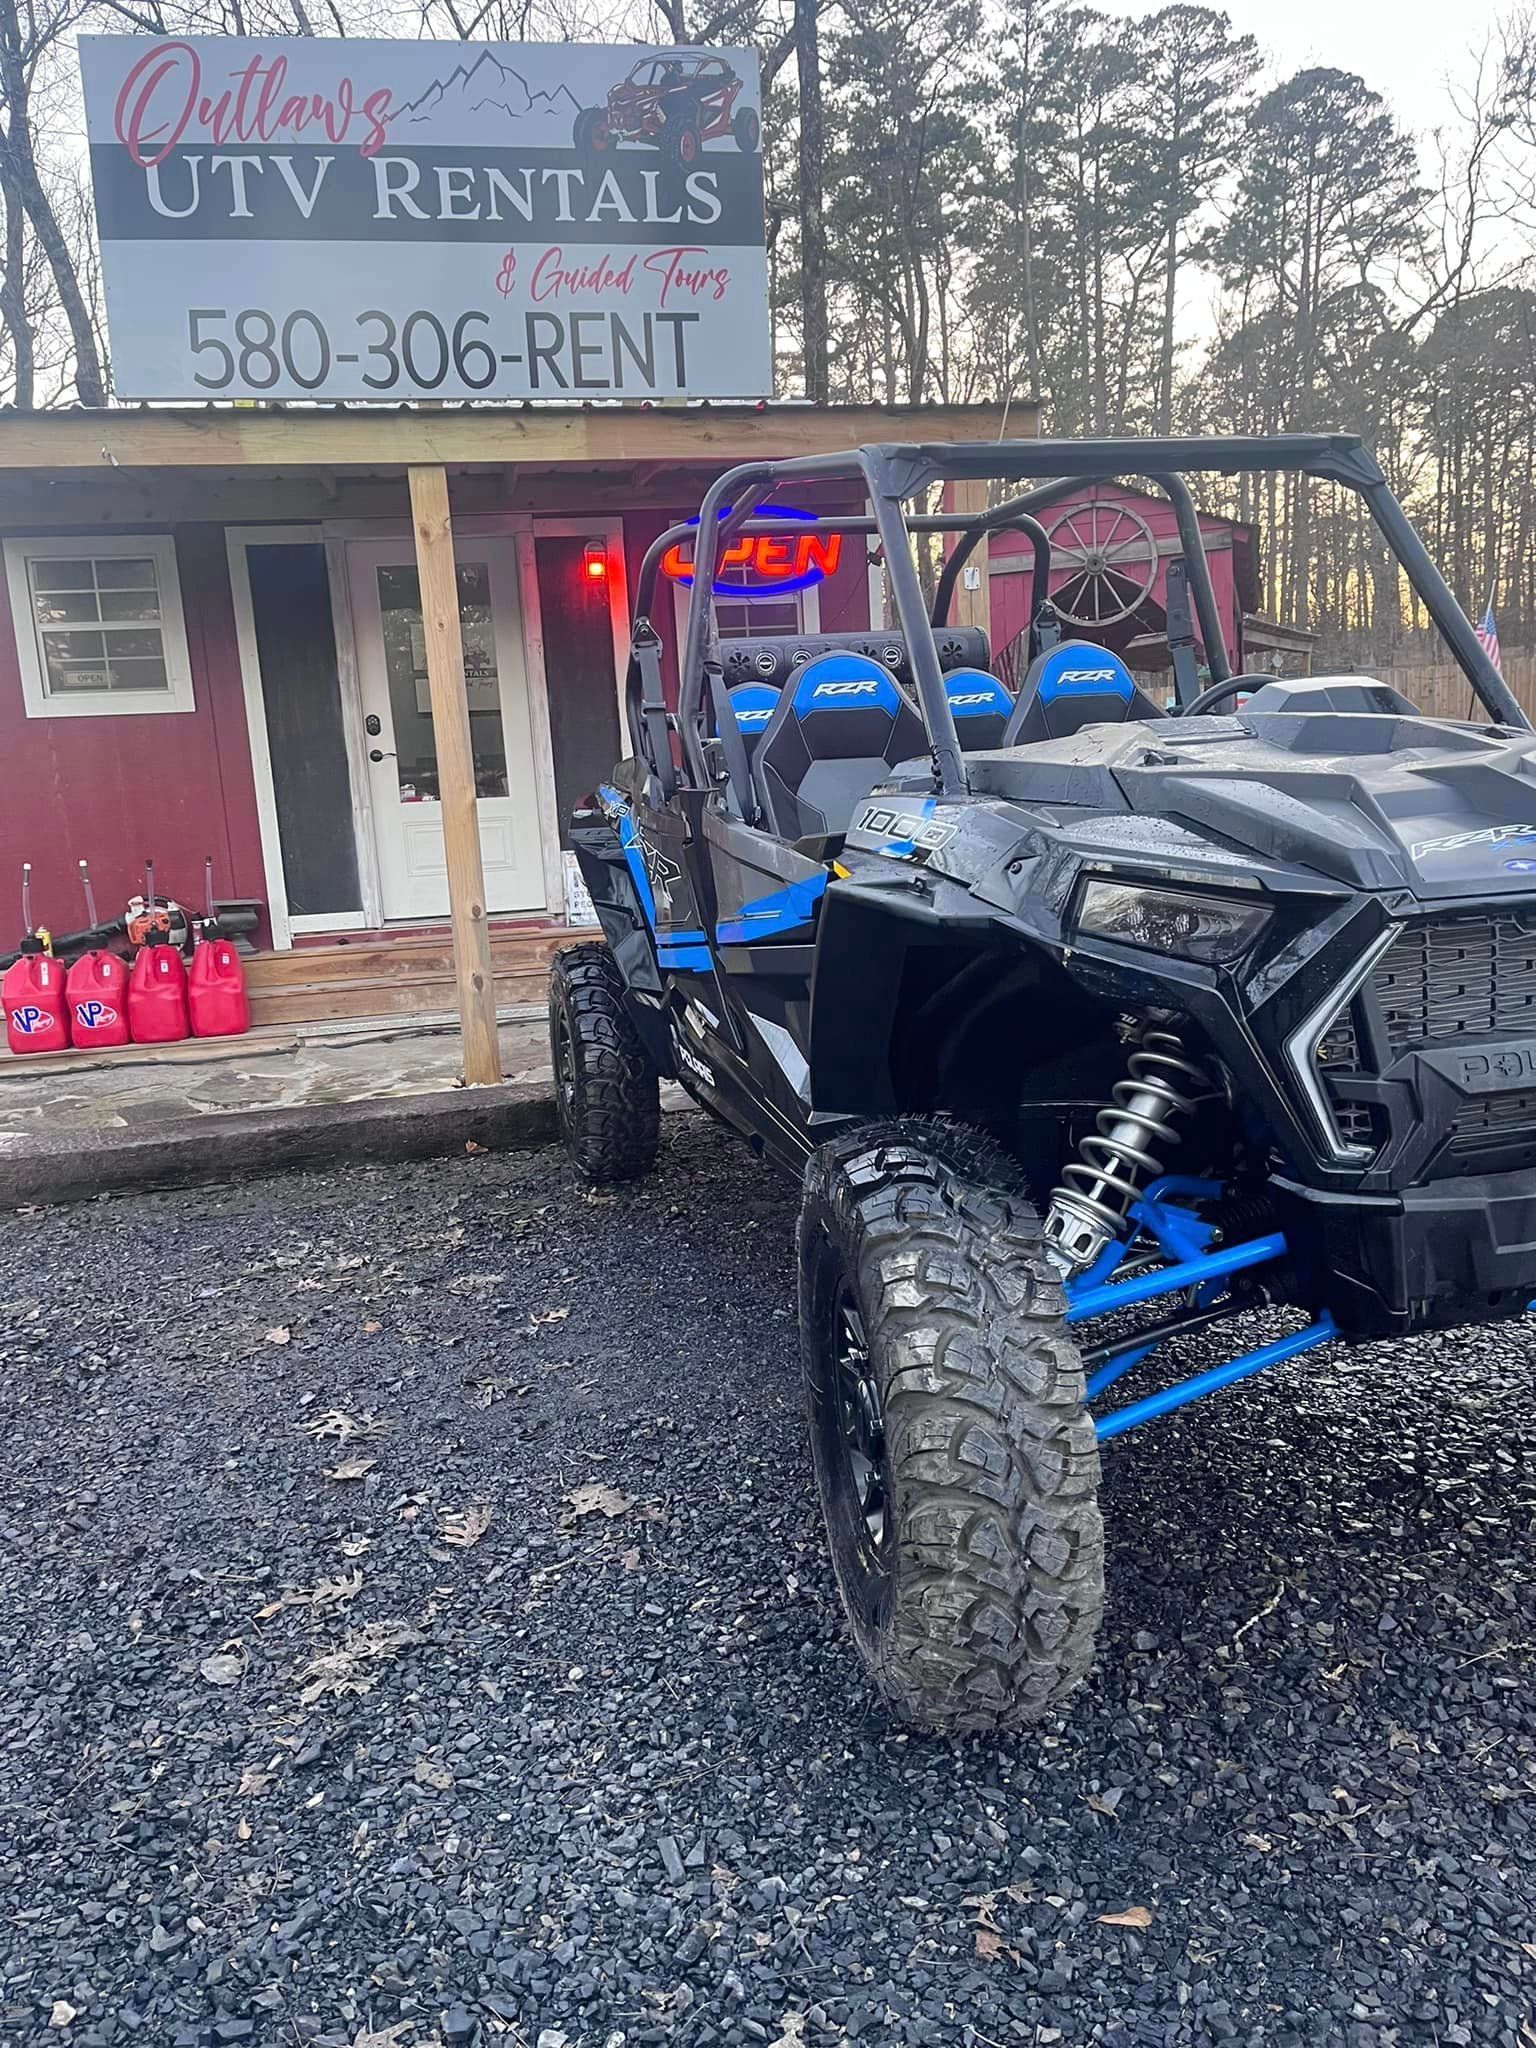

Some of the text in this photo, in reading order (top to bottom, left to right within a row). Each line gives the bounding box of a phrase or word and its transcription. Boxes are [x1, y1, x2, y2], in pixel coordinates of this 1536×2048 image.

[114, 41, 393, 168] Outlaws
[140, 155, 723, 225] UTV RENTALS
[495, 246, 731, 309] & Guided Tours
[187, 309, 701, 390] 580-306-RENT
[812, 680, 879, 698] RZR
[1057, 669, 1116, 684] RZR
[947, 692, 995, 705] RZR
[856, 806, 958, 851] 1000
[1411, 824, 1536, 860] RZR
[1457, 1049, 1536, 1082] POL
